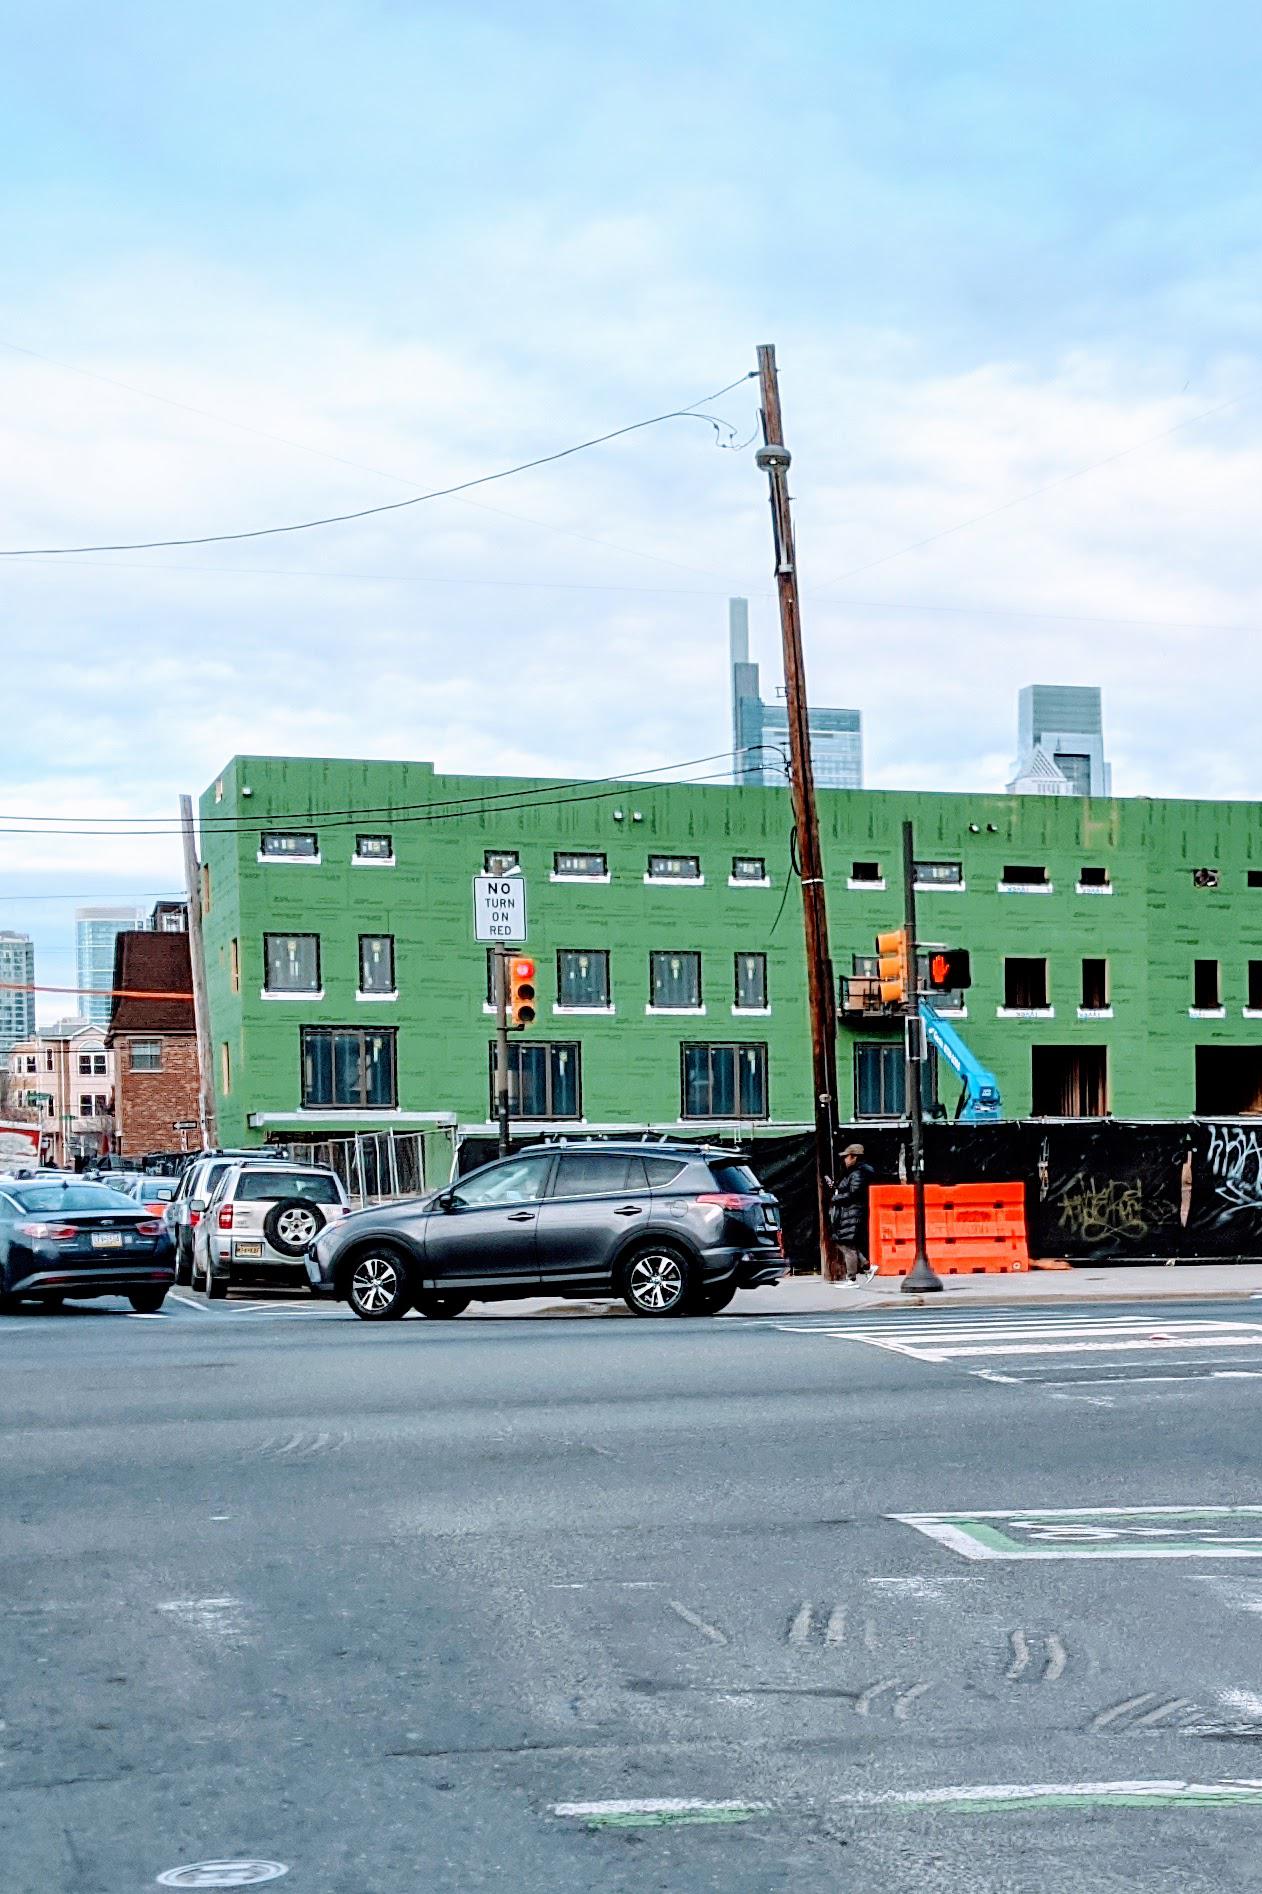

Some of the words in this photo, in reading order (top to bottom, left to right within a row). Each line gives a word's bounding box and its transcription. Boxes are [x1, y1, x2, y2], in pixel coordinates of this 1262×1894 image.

[488, 882, 511, 895] NO
[485, 898, 515, 909] TURN
[492, 911, 509, 922] ON
[490, 925, 512, 936] RED
